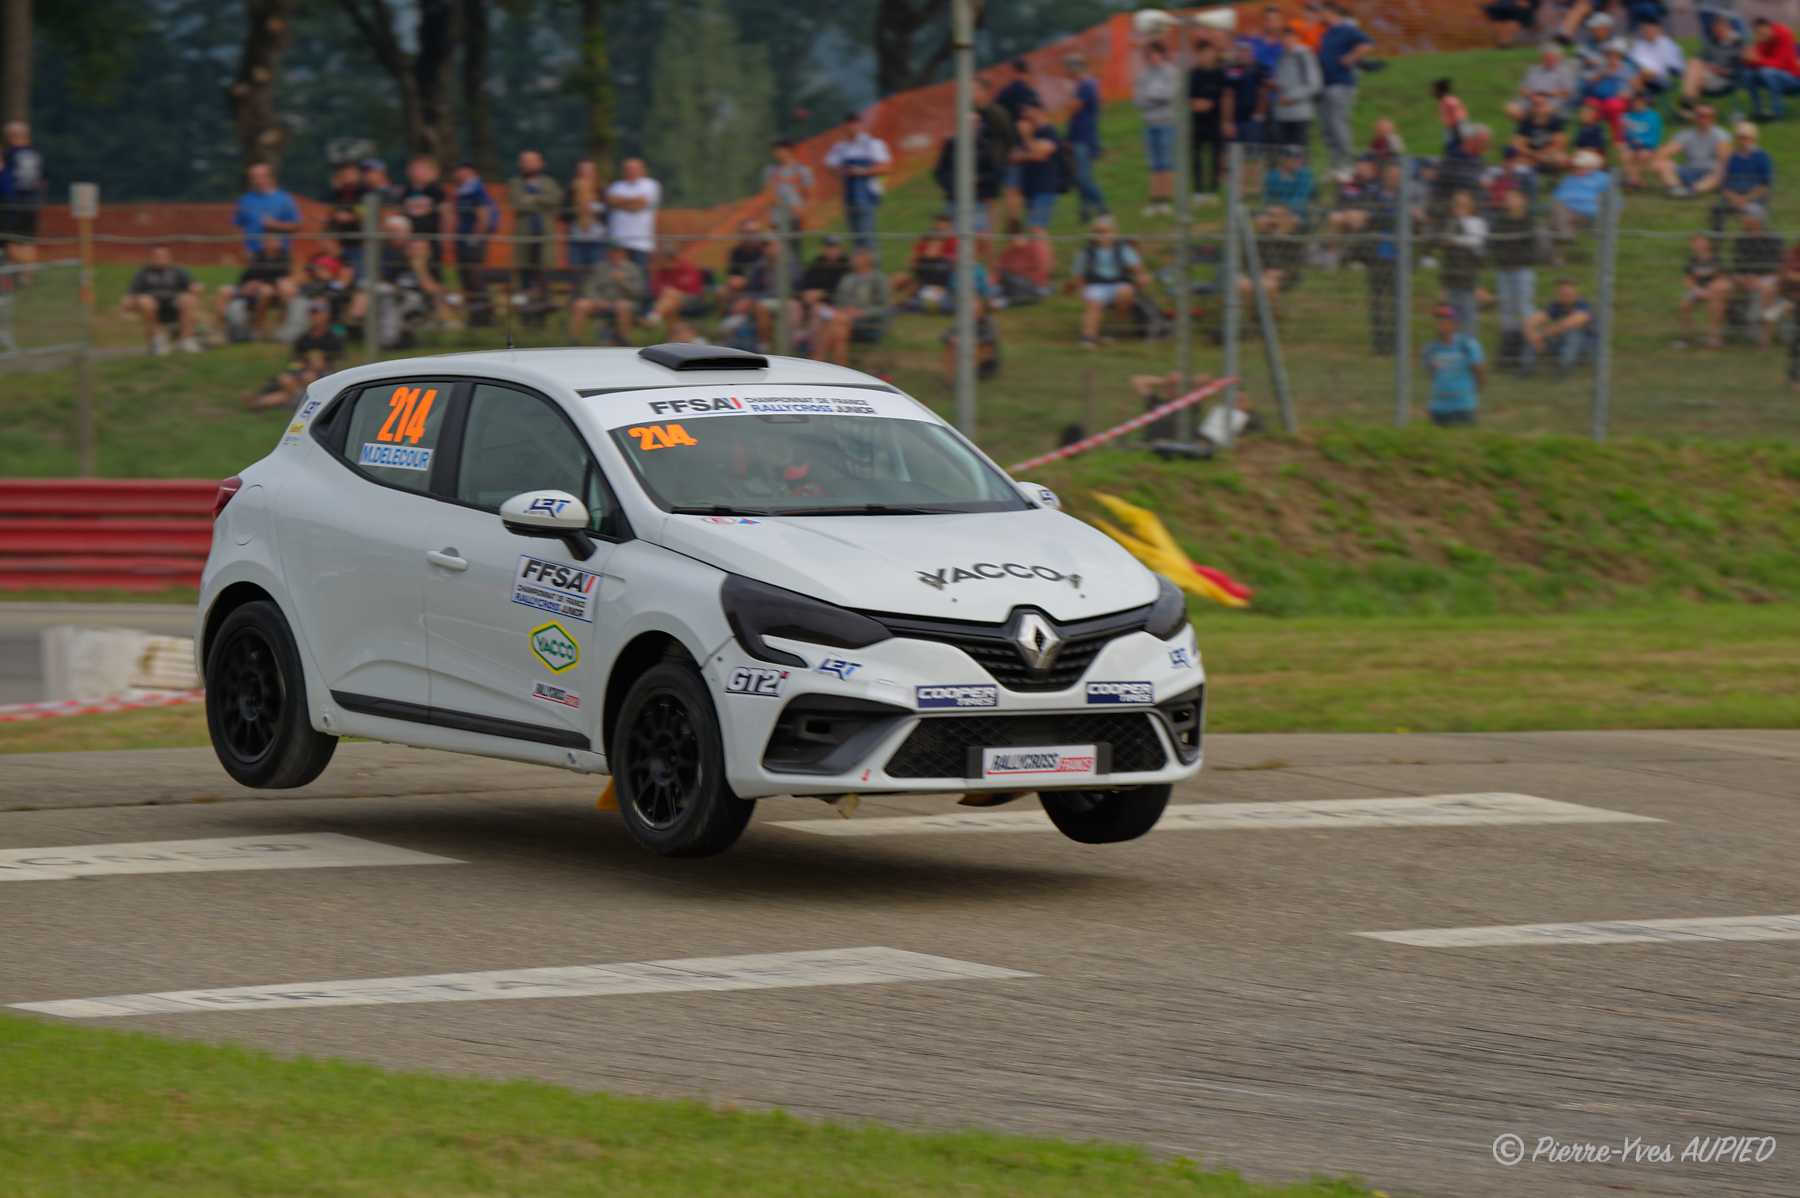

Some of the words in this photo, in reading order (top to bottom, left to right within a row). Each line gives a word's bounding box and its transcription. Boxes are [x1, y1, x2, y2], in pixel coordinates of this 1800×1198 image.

[376, 386, 438, 444] 214
[648, 398, 734, 415] FFSA
[750, 404, 832, 412] RALLYCROSS
[627, 423, 698, 451] 214
[522, 559, 585, 593] FFSA
[918, 686, 996, 699] COOPER
[1088, 683, 1152, 695] COOPER
